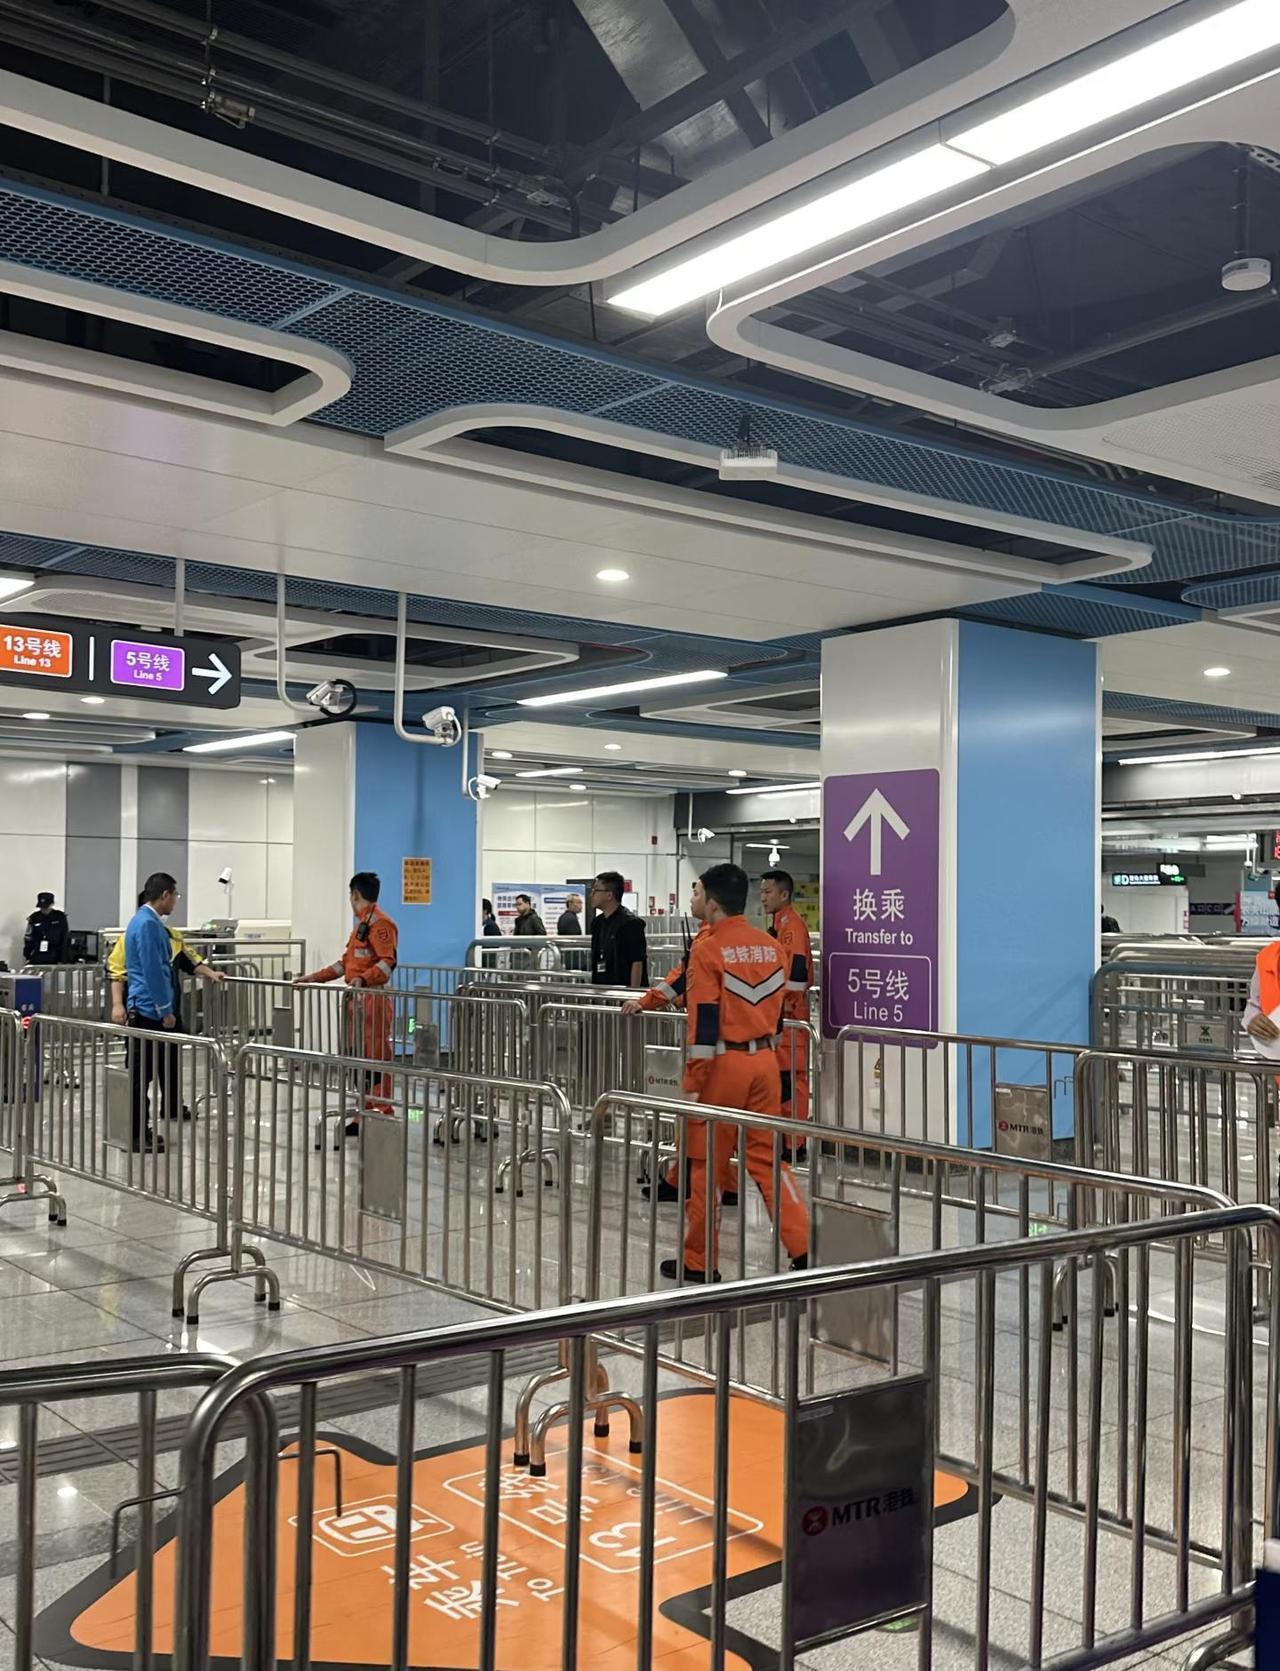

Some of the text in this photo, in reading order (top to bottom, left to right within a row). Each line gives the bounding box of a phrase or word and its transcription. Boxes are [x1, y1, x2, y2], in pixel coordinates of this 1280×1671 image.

[3, 635, 62, 658] 13号线
[13, 654, 51, 668] Line 13
[126, 651, 170, 671] 5号线
[133, 669, 163, 681] Line 5
[853, 888, 905, 922] 换乘
[845, 928, 913, 945] Transfer to
[720, 945, 777, 963] 地铁消防
[848, 968, 909, 1000] 5号线
[854, 1001, 903, 1022] Line 5
[832, 1496, 881, 1527] MTR
[527, 1578, 566, 1602] To
